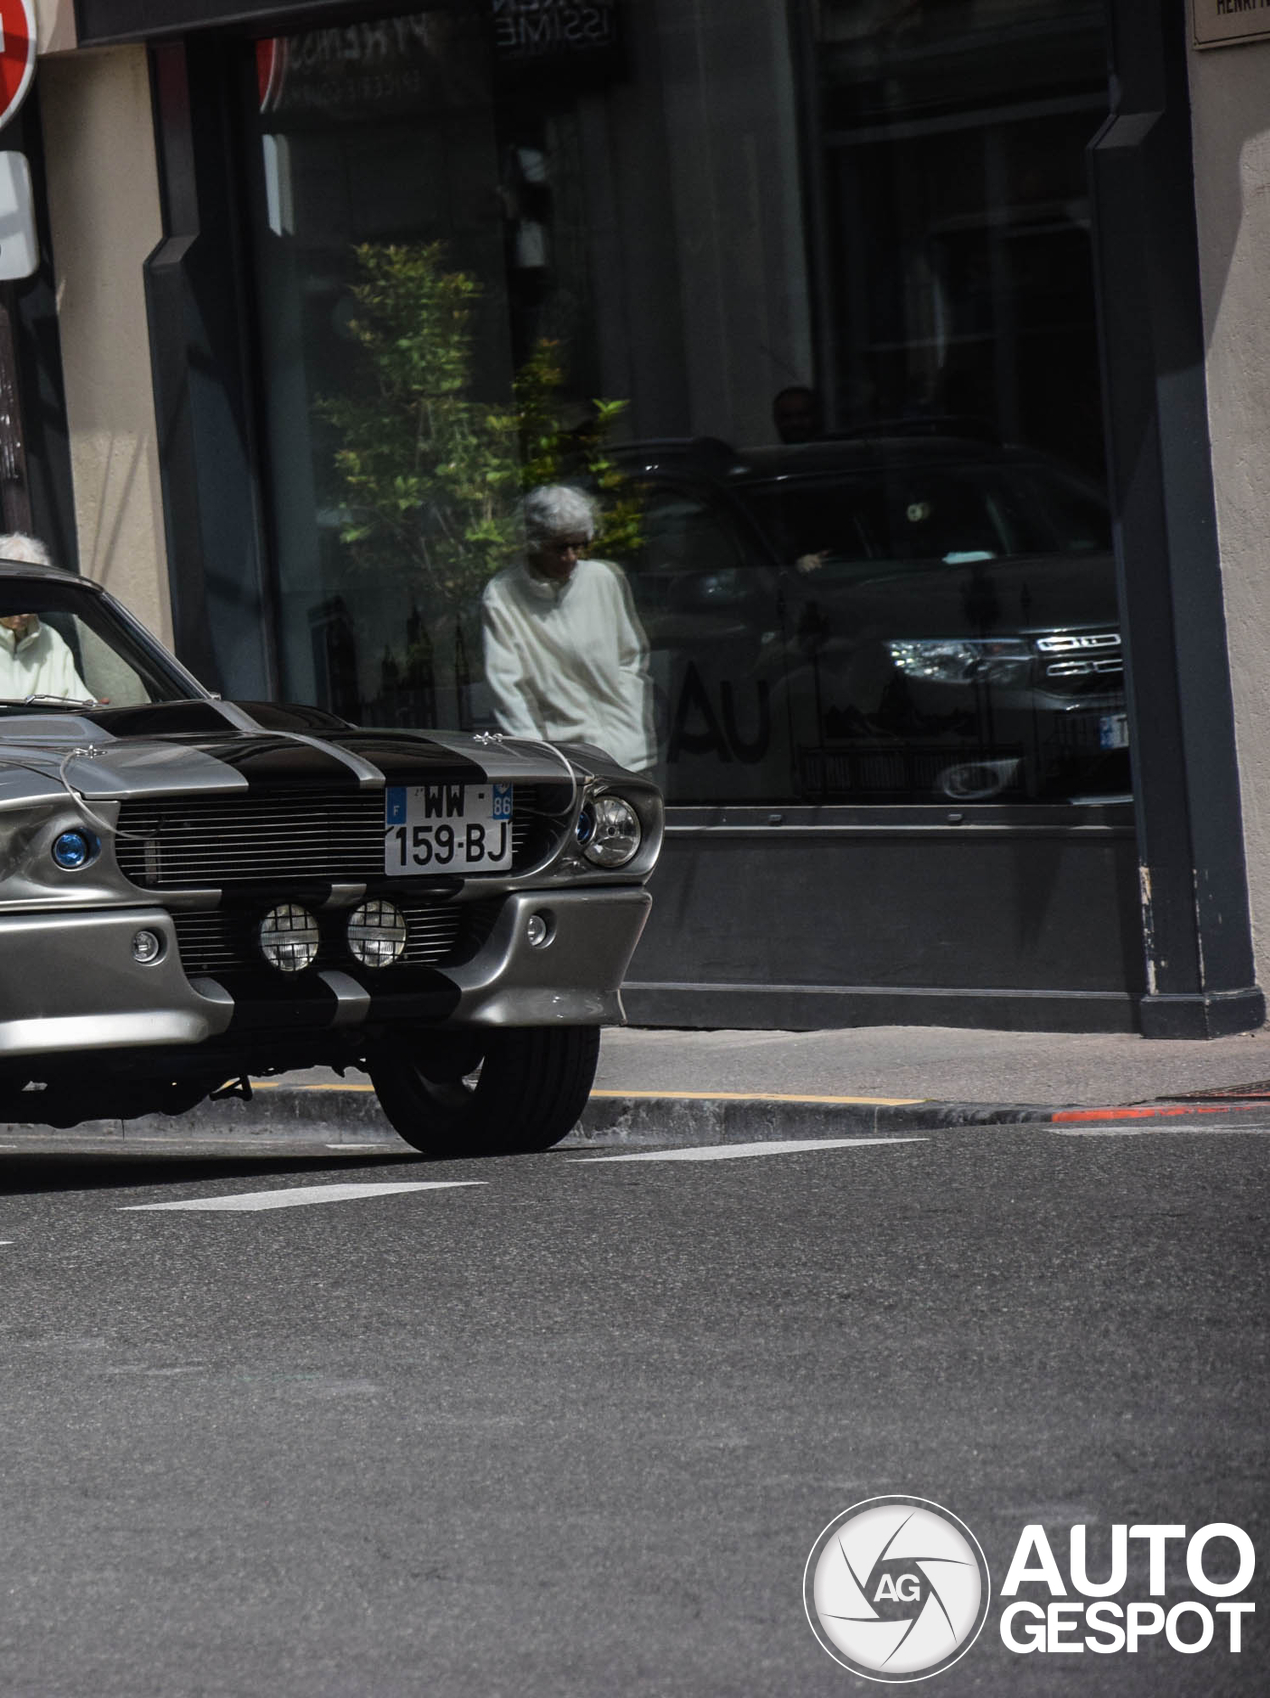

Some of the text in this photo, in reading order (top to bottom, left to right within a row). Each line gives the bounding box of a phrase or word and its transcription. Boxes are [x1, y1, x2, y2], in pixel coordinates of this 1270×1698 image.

[392, 805, 400, 816] F
[493, 797, 511, 816] 86
[395, 822, 507, 866] 159-BJ
